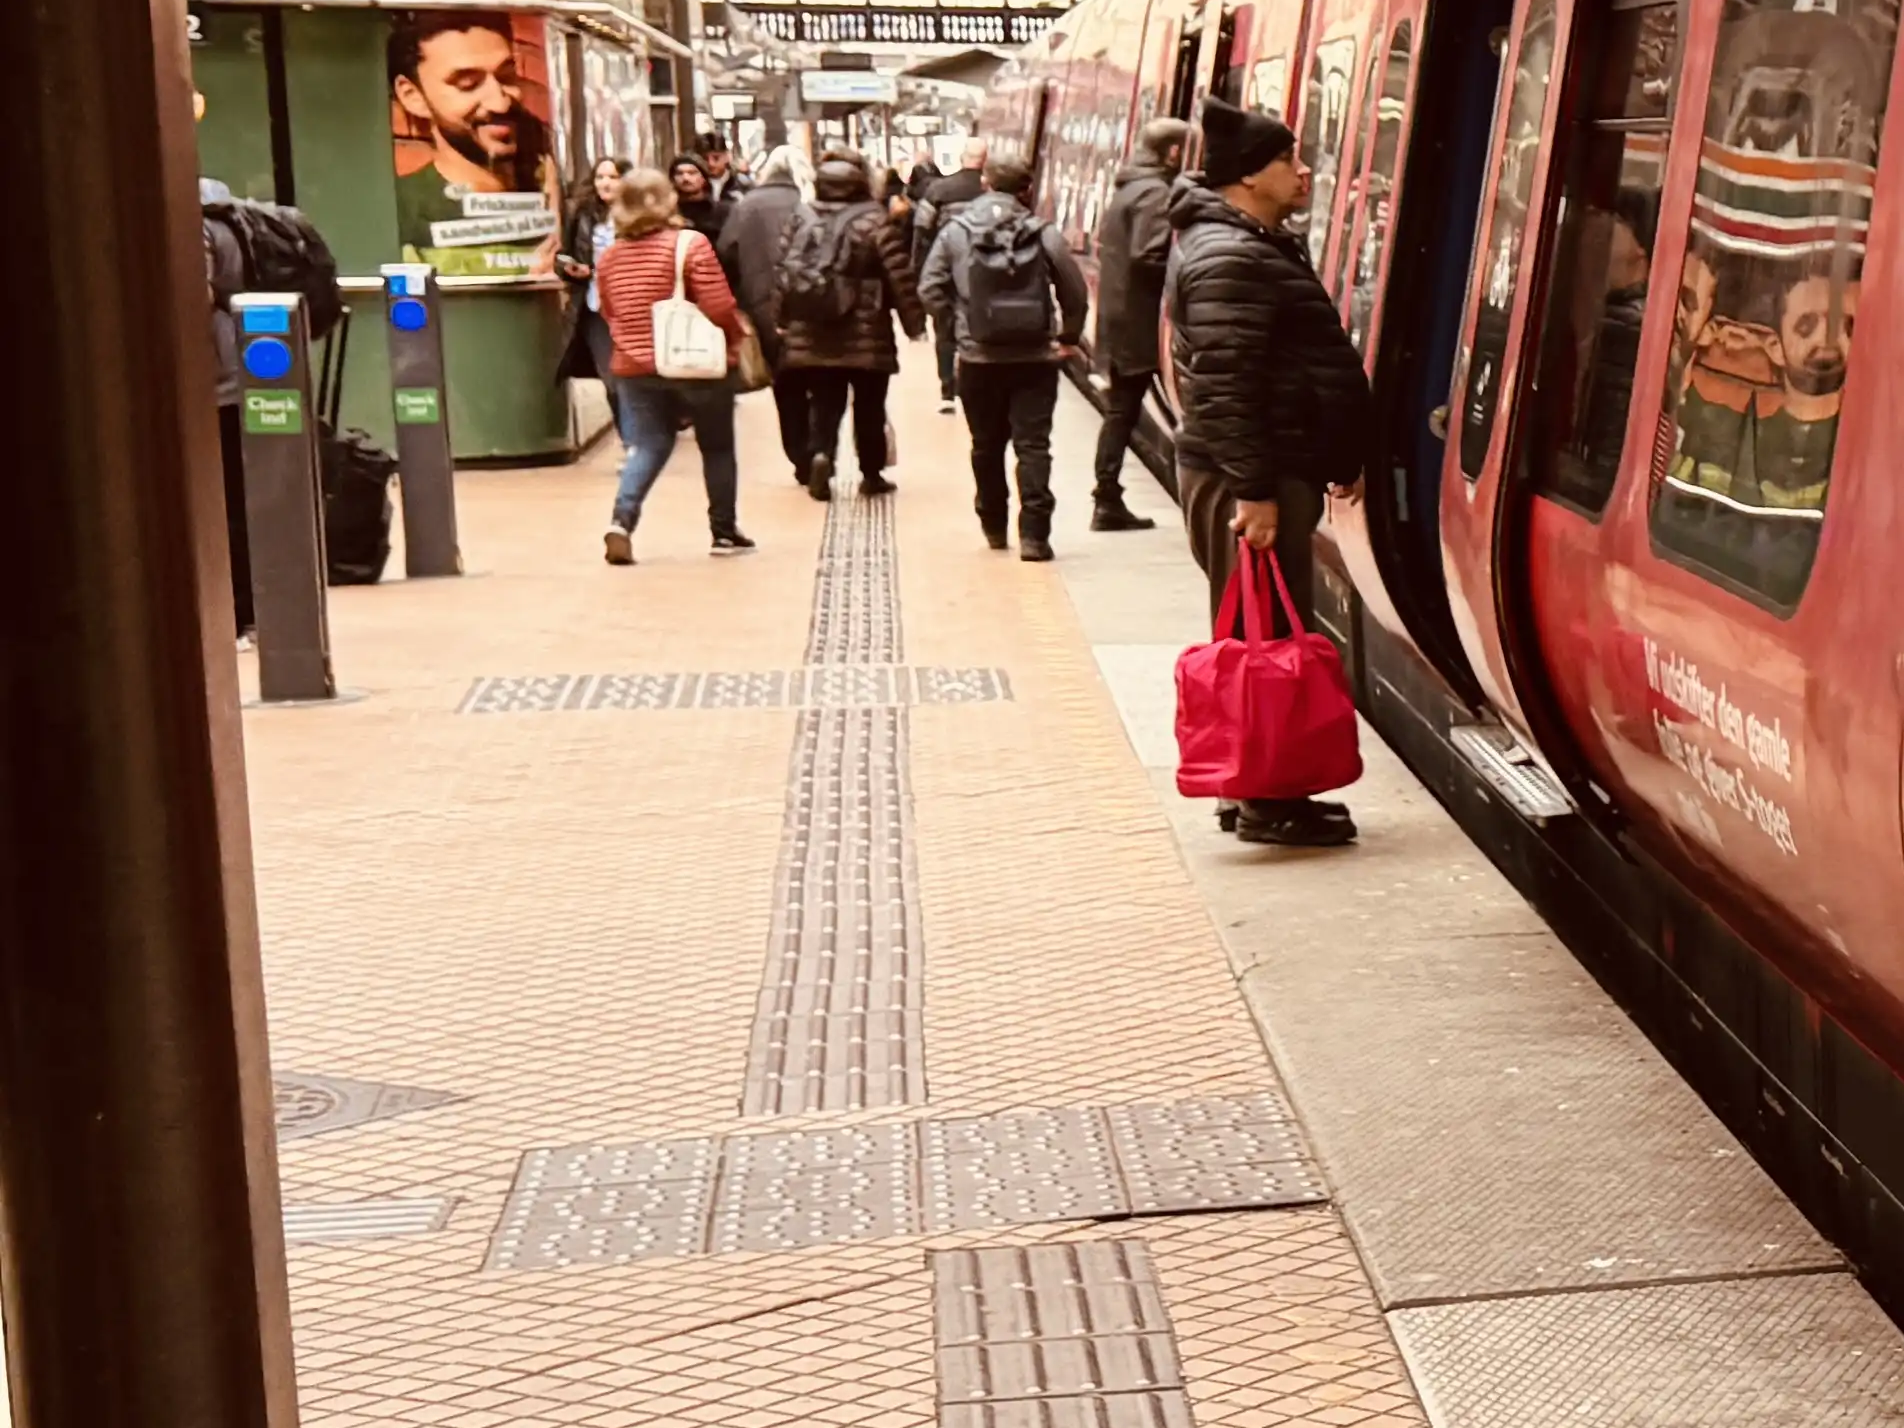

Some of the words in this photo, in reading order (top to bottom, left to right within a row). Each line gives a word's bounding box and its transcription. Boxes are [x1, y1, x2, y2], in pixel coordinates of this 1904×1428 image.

[247, 397, 298, 412] Check
[1643, 636, 1661, 694] Vi
[1717, 681, 1746, 750] den
[1746, 711, 1792, 783] gamle
